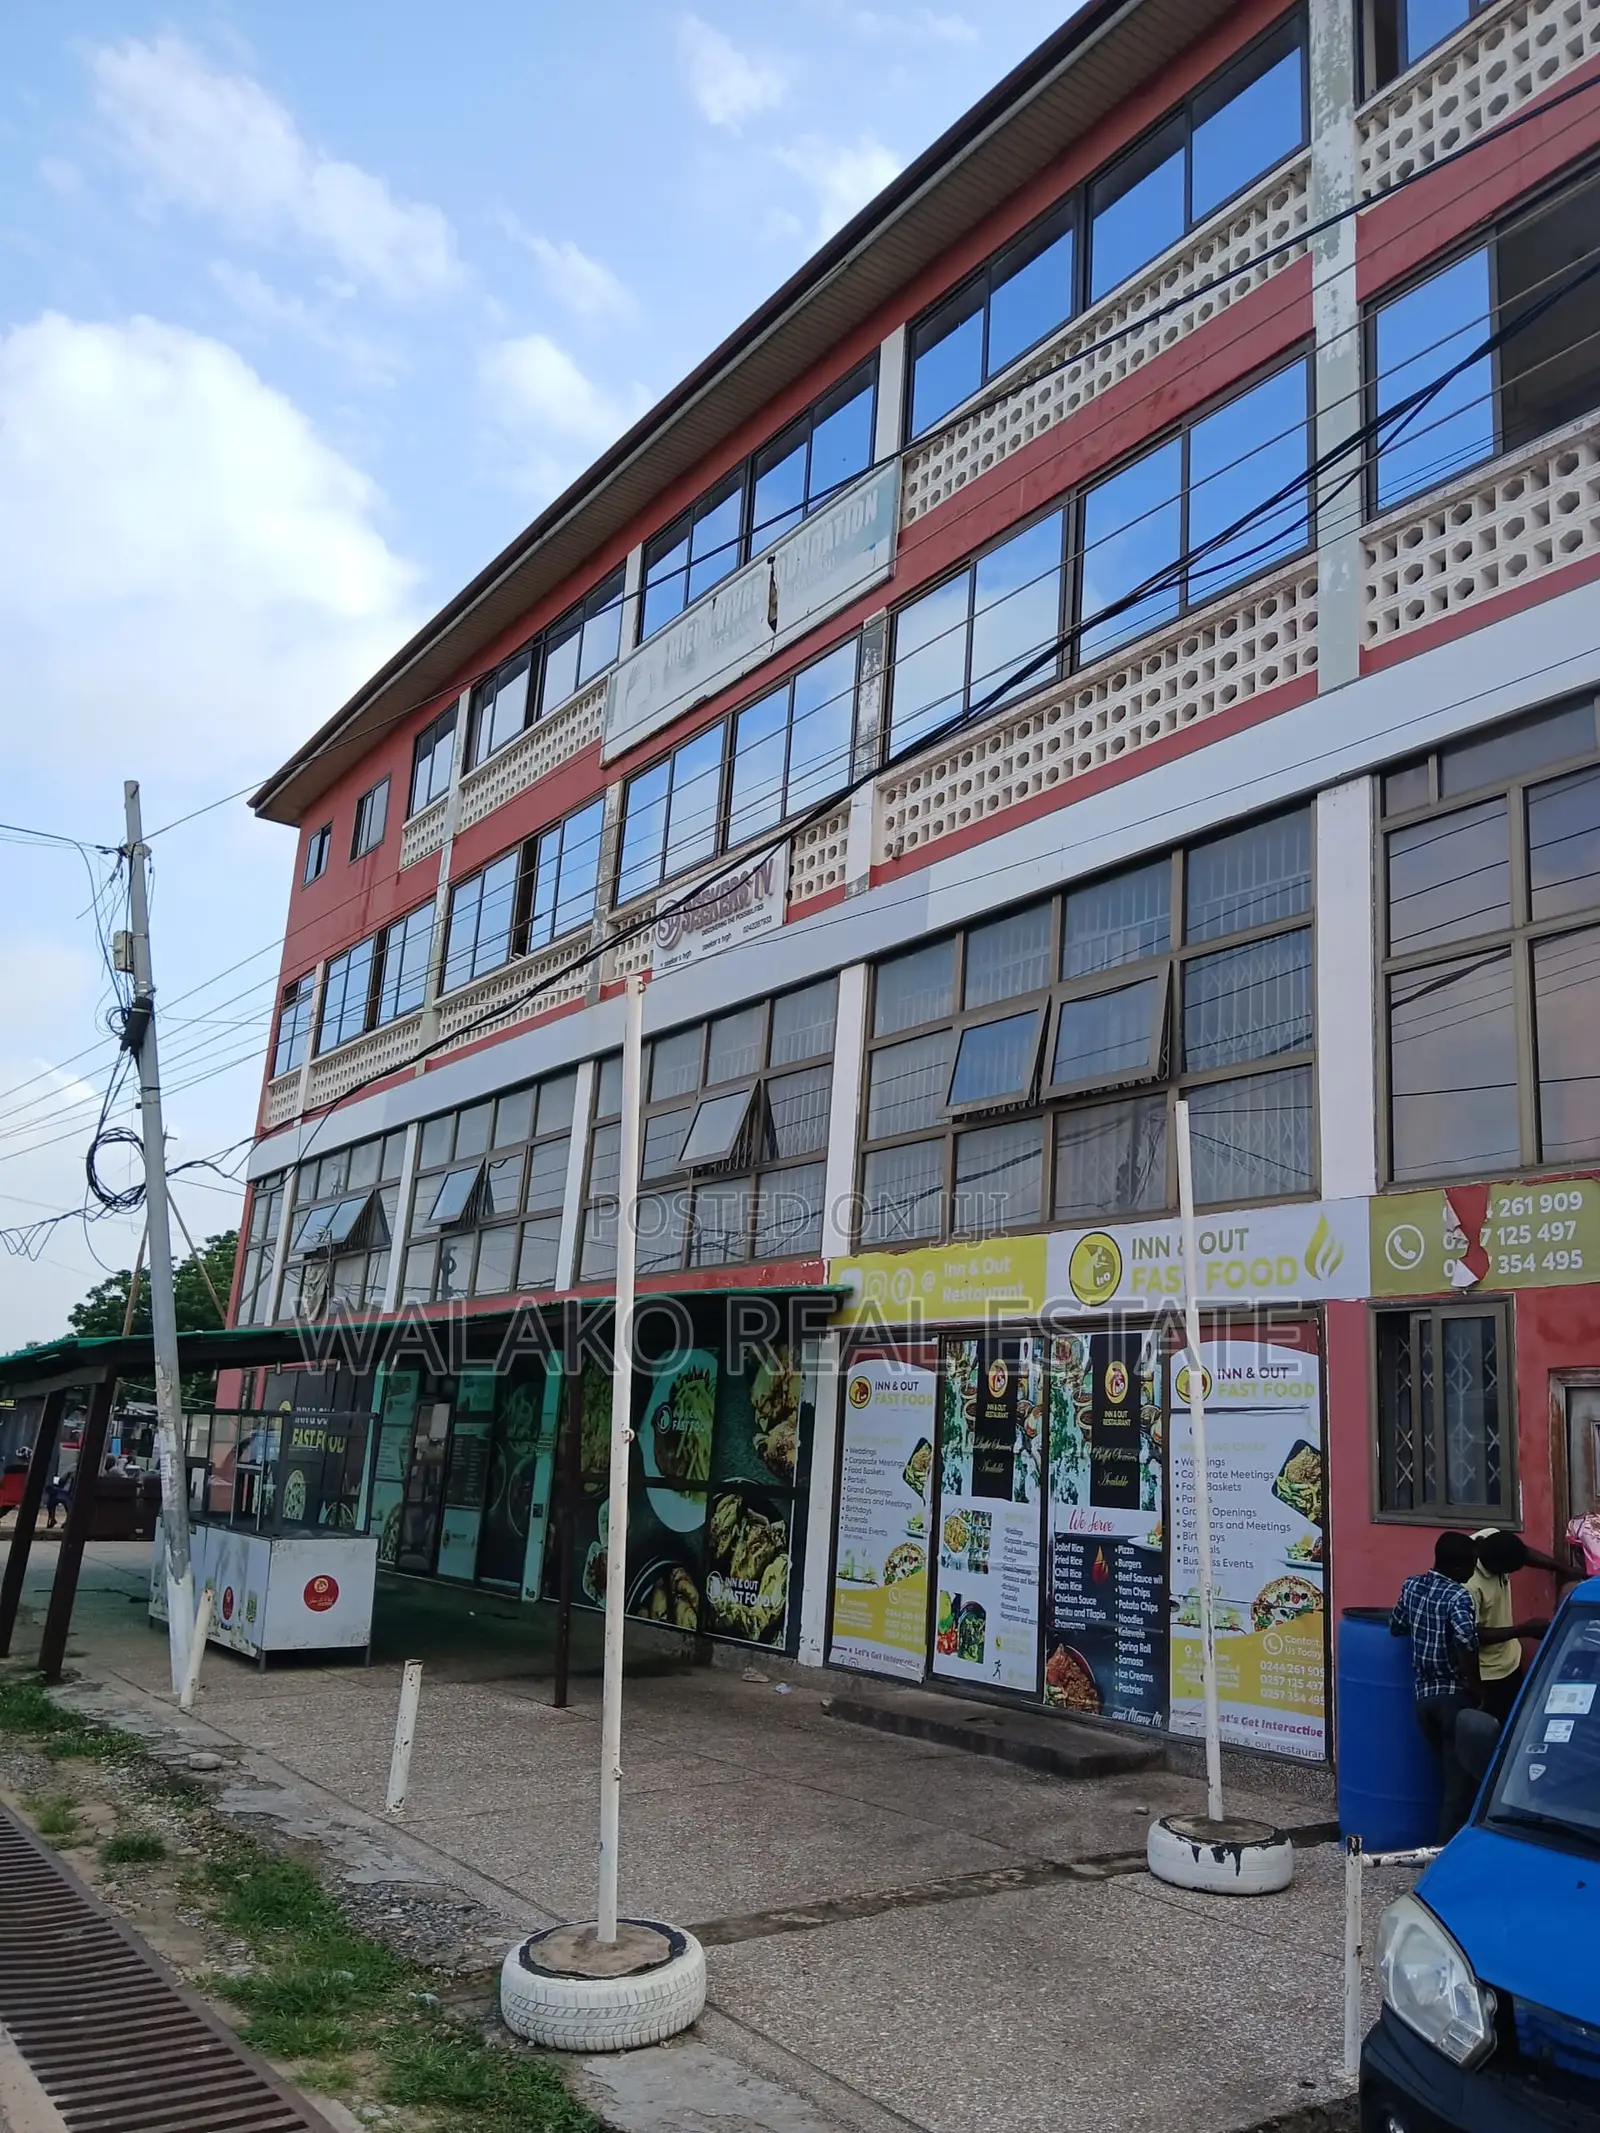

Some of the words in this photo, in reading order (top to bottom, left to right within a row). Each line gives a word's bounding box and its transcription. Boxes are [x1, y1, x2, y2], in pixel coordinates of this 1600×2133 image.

[1499, 1197, 1534, 1217] 261
[1539, 1191, 1583, 1214] 909
[1497, 1225, 1531, 1246] 125
[1537, 1220, 1576, 1241] 497
[1131, 1235, 1170, 1260] INN
[1198, 1227, 1250, 1255] OUT
[944, 1261, 965, 1277] Inn
[969, 1260, 979, 1276] &
[982, 1257, 1011, 1273] Out
[1498, 1252, 1536, 1274] 354
[1541, 1250, 1583, 1271] 495
[1205, 1256, 1298, 1292] FOOD
[943, 1283, 1026, 1304] Restaurant
[1217, 1368, 1242, 1380] INN
[1246, 1368, 1255, 1379] &
[1259, 1367, 1289, 1379] OUT
[874, 1381, 890, 1391] INN
[892, 1381, 899, 1391] &
[900, 1381, 919, 1391] OUT
[1217, 1383, 1258, 1398] FAST
[1263, 1382, 1315, 1397] FOOD
[874, 1393, 900, 1405] FAST
[1102, 1418, 1131, 1426] RESTAURANT
[291, 1428, 316, 1447] FAST
[848, 1456, 877, 1466] Corporate
[1181, 1458, 1225, 1468] Weings
[847, 1466, 862, 1475] Food
[1181, 1470, 1228, 1479] Corate
[1230, 1470, 1274, 1480] Meetings
[846, 1485, 864, 1494] Grand
[1207, 1482, 1242, 1492] Baskets
[1182, 1494, 1212, 1503] Pars
[1212, 1507, 1257, 1518] Openings
[1069, 1508, 1085, 1530] We
[1226, 1521, 1243, 1530] and
[1246, 1522, 1291, 1533] Meetings
[1183, 1532, 1225, 1543] Birtays
[1054, 1543, 1071, 1552] Jollof
[1071, 1544, 1084, 1553] Rice
[1118, 1545, 1134, 1555] Pizza
[1183, 1544, 1220, 1554] Funals
[1054, 1555, 1070, 1565] Fried
[1070, 1556, 1083, 1566] Rice
[1118, 1558, 1142, 1570] Burgers
[1183, 1557, 1220, 1566] Busss
[1222, 1559, 1254, 1568] Events
[1070, 1569, 1083, 1579] Rice
[1118, 1572, 1132, 1582] Beef
[1133, 1574, 1152, 1584] Sauce
[724, 1577, 738, 1587] INN
[744, 1579, 759, 1591] OUT
[1054, 1580, 1069, 1590] Plain
[1070, 1581, 1083, 1591] Rice
[1118, 1585, 1132, 1595] Yam
[1133, 1587, 1150, 1599] Chips
[1055, 1593, 1078, 1604] Chicken
[1079, 1596, 1097, 1605] Sauce
[1119, 1599, 1139, 1610] Potato
[1140, 1602, 1158, 1613] Chips
[1055, 1606, 1074, 1616] Banku
[1074, 1607, 1085, 1617] and
[1086, 1608, 1106, 1620] Tilapia
[1119, 1613, 1144, 1625] Noodles
[1118, 1626, 1145, 1638] Kelewele
[1118, 1641, 1139, 1653] Spring
[1140, 1643, 1151, 1653] Roll
[1285, 1647, 1296, 1655] Us
[1297, 1649, 1322, 1660] Today
[1119, 1656, 1143, 1666] Samosa
[1288, 1663, 1305, 1674] 261
[1119, 1670, 1128, 1679] Ice
[1129, 1672, 1153, 1682] Creams
[1287, 1677, 1304, 1688] 125
[1119, 1684, 1144, 1695] Pastries
[1112, 1711, 1127, 1720] and
[1128, 1707, 1150, 1724] Many
[1220, 1714, 1239, 1724] et's
[1241, 1717, 1260, 1727] Get
[1261, 1718, 1323, 1737] Interactive
